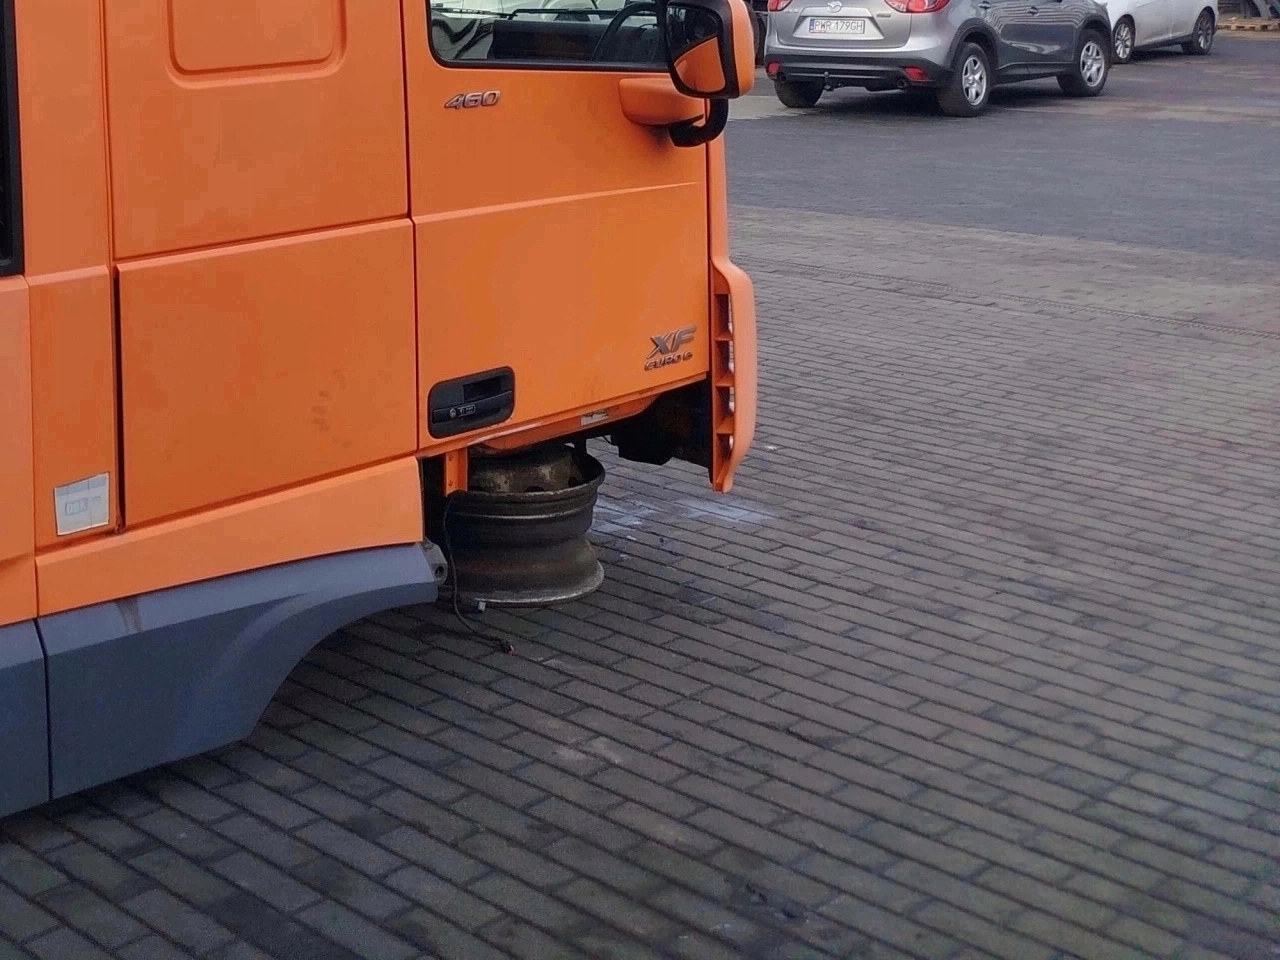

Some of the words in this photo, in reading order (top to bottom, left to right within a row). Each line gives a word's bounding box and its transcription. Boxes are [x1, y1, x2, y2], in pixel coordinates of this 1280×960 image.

[814, 20, 832, 31] PWR
[835, 21, 863, 32] 179GH
[444, 90, 501, 109] 460
[646, 324, 698, 360] XF
[644, 353, 682, 371] EURO
[683, 351, 693, 361] 6
